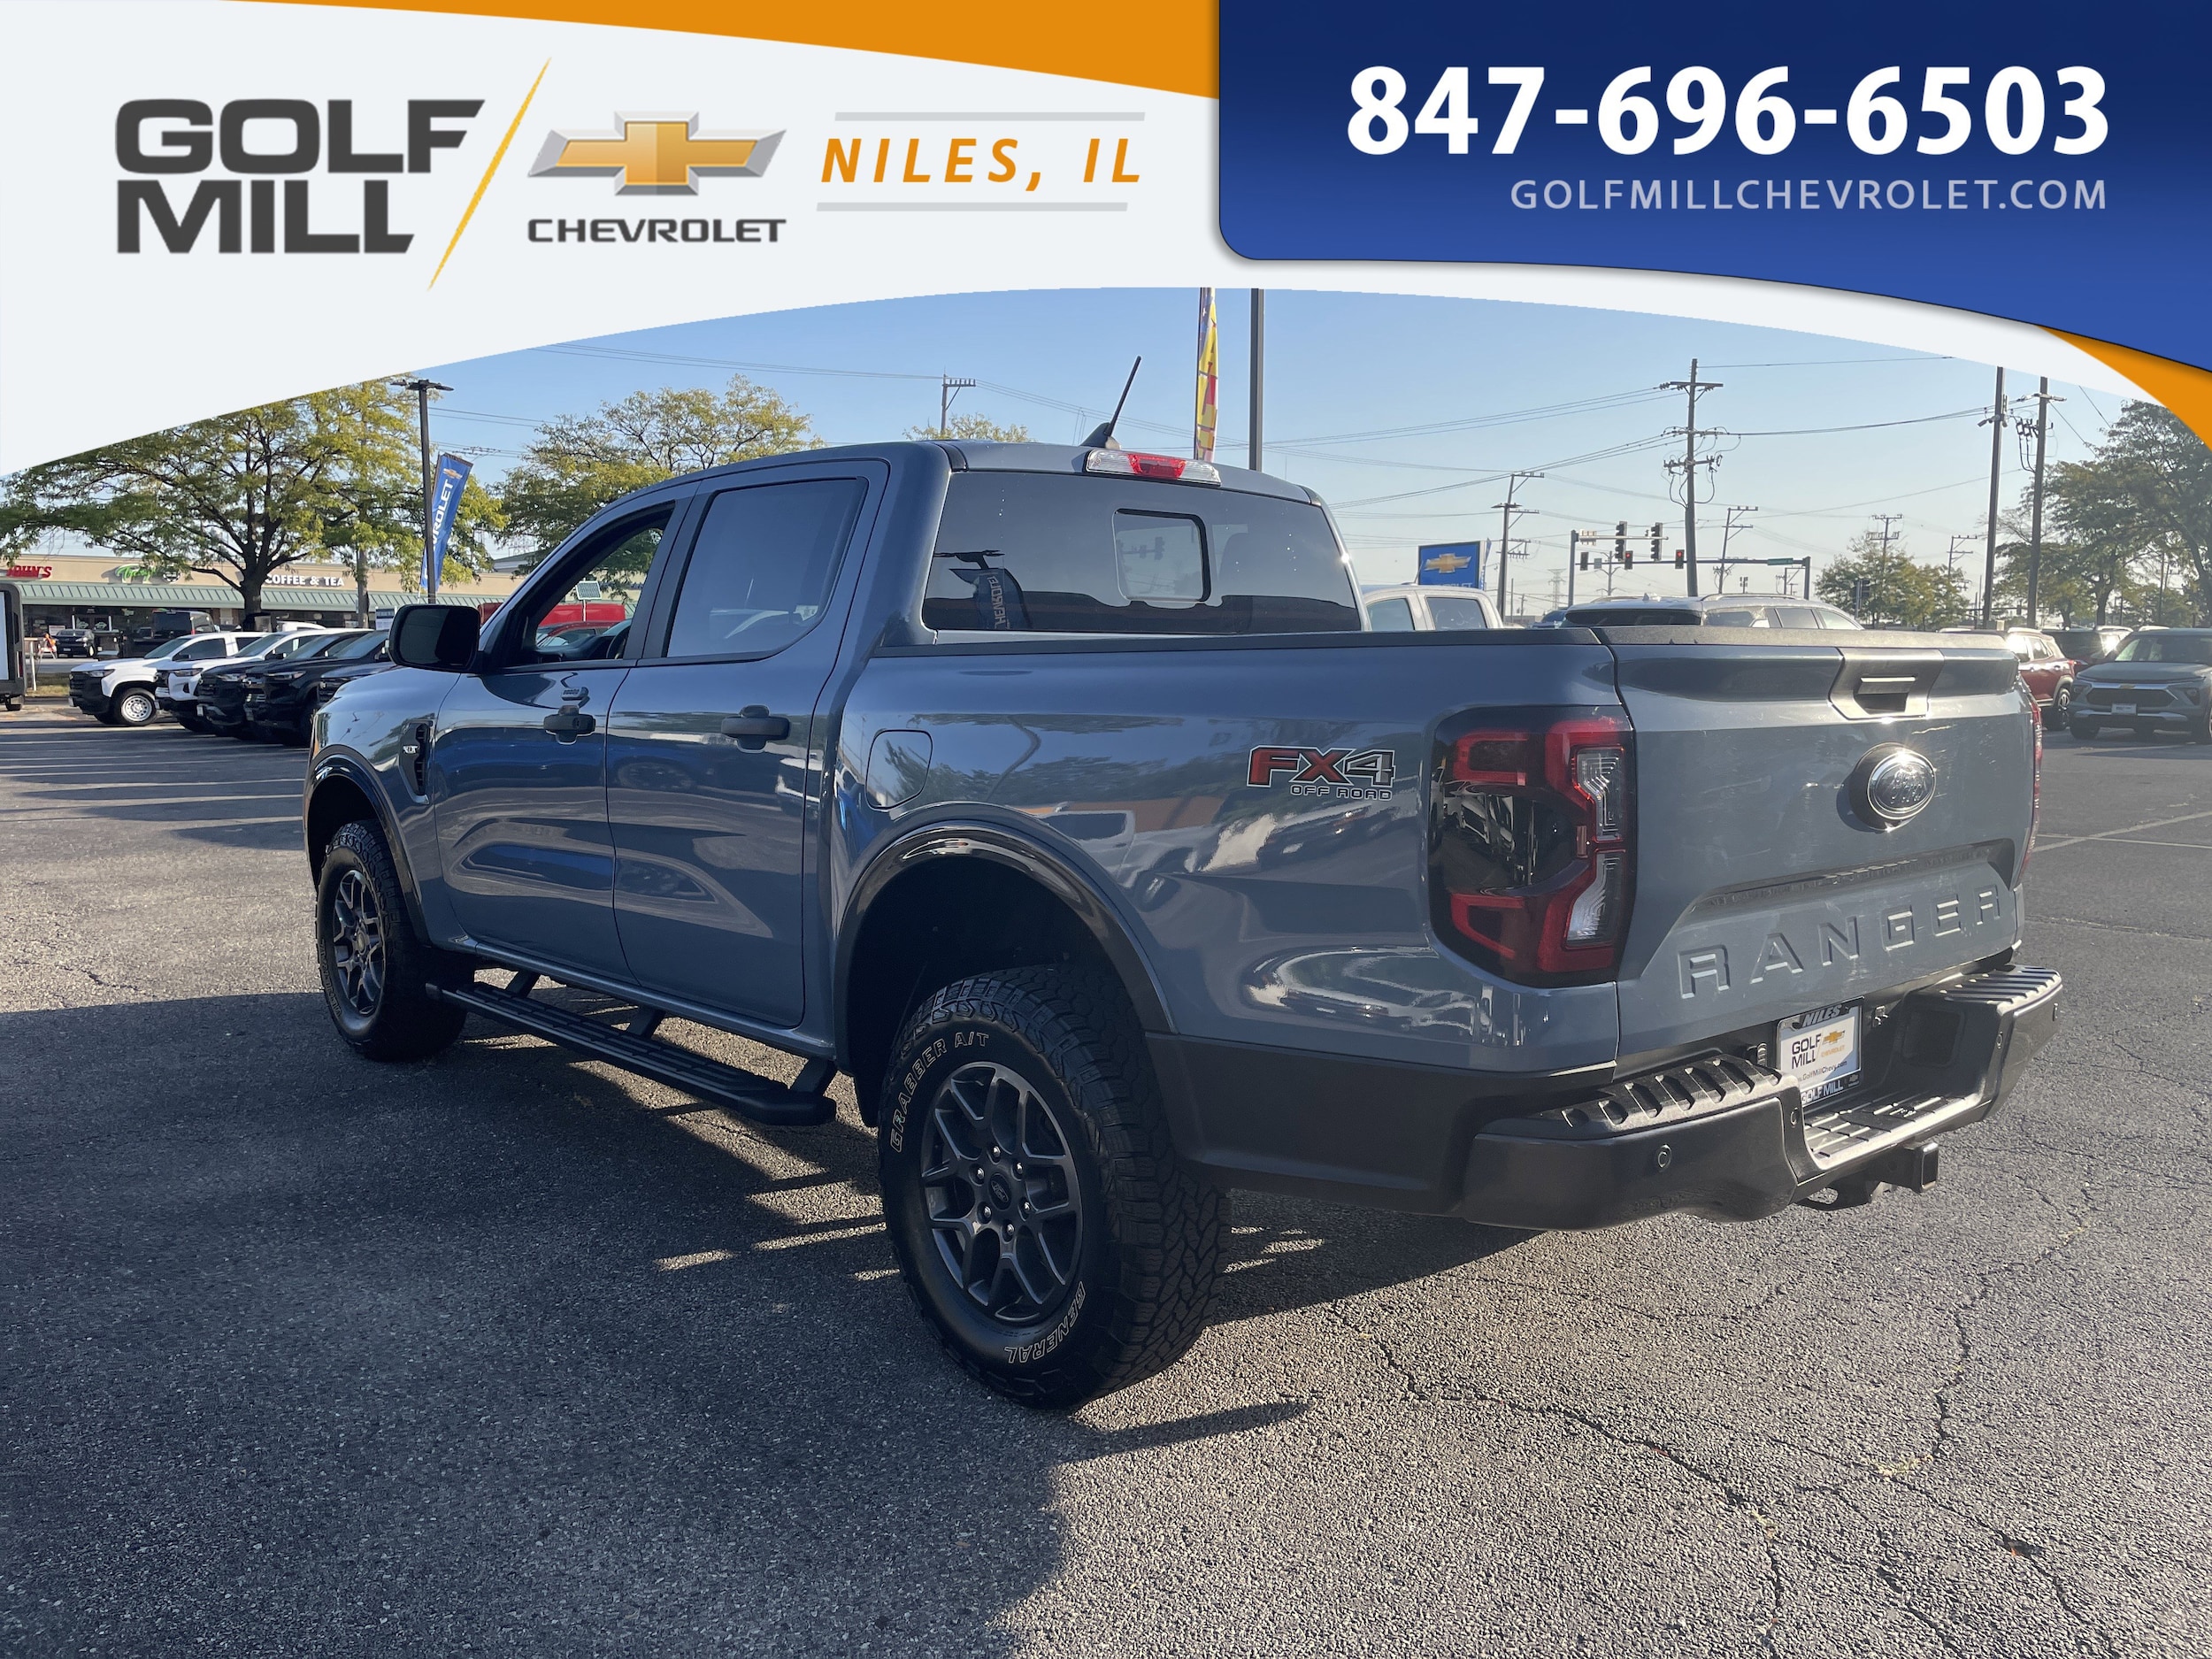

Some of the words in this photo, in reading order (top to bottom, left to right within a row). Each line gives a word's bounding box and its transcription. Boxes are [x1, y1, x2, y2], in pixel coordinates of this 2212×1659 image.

[265, 573, 306, 585] COFFEE
[310, 576, 320, 586] &
[323, 576, 345, 587] TEA
[1246, 745, 1396, 788] FX4
[1290, 784, 1330, 796] OFF
[1335, 786, 1393, 802] ROAD
[1678, 885, 2001, 999] RANGER
[1802, 1004, 1842, 1026] NILES
[1792, 1033, 1821, 1055] GOLF
[1791, 1049, 1816, 1070] MILL
[889, 1037, 949, 1153] GRABBER
[954, 1031, 990, 1048] A/T
[1801, 1086, 1824, 1105] GOLF
[1823, 1079, 1844, 1097] MILL
[1003, 1280, 1087, 1364] GENERAL
